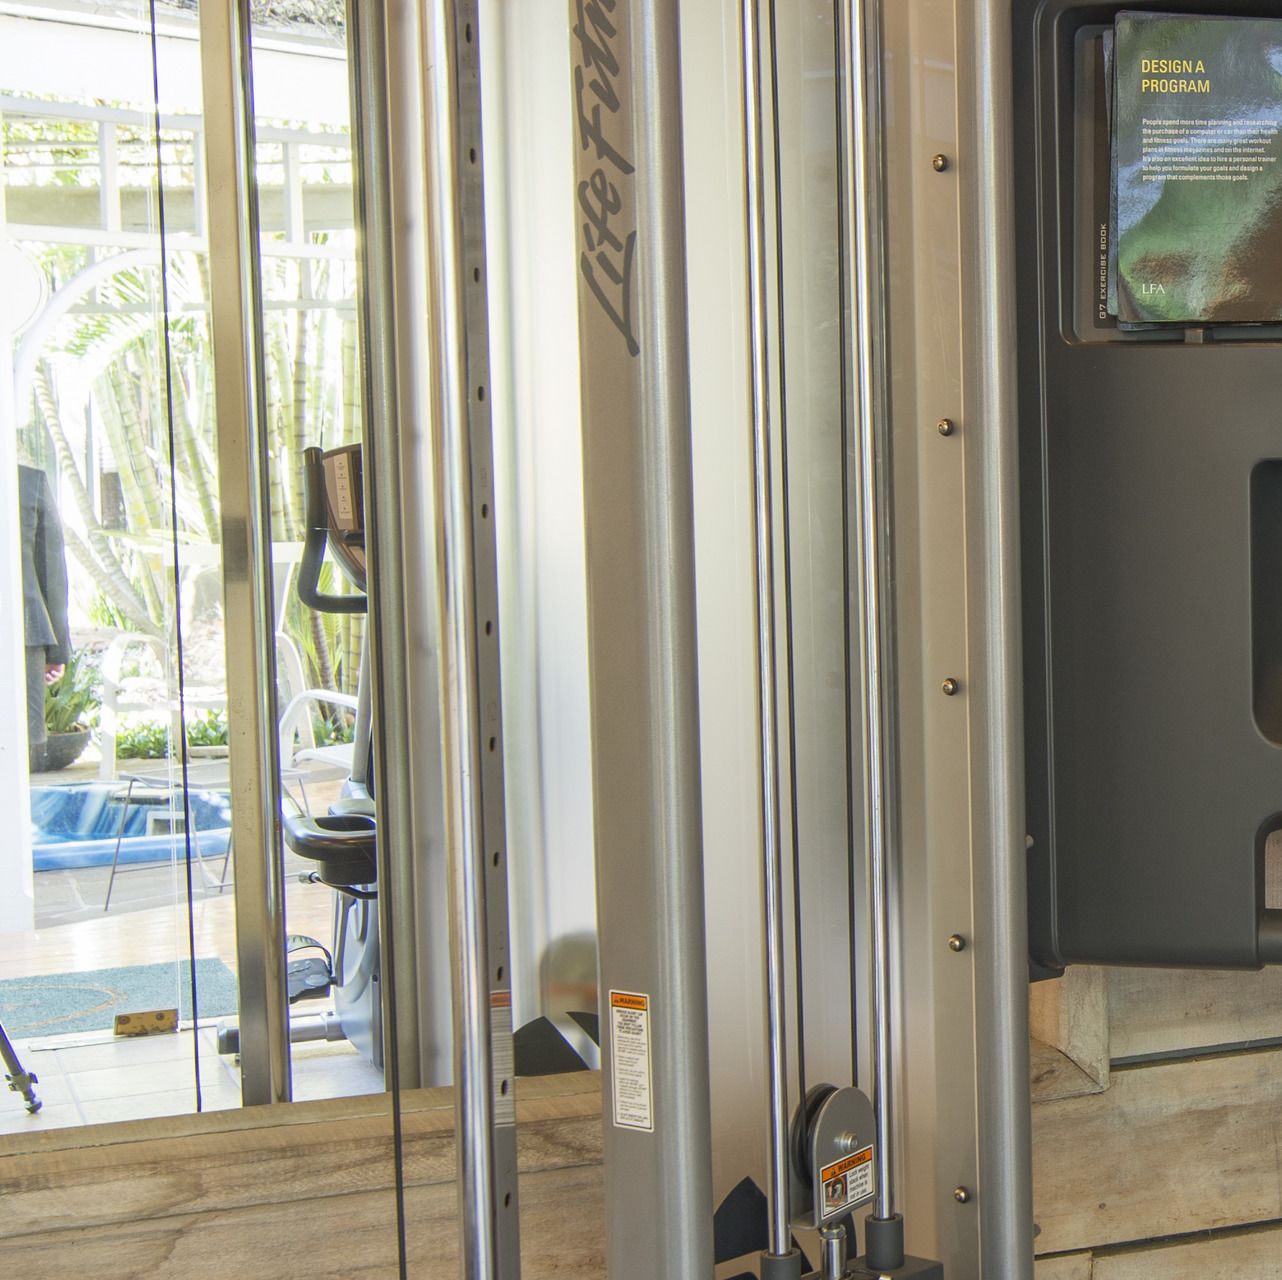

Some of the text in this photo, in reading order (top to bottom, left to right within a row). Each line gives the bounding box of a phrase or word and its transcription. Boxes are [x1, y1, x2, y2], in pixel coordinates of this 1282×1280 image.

[1141, 59, 1206, 74] DESIGN A
[1141, 79, 1211, 94] PROGRAM
[1141, 283, 1166, 295] LFA
[1099, 303, 1107, 319] G7
[839, 1153, 866, 1171] WARNING
